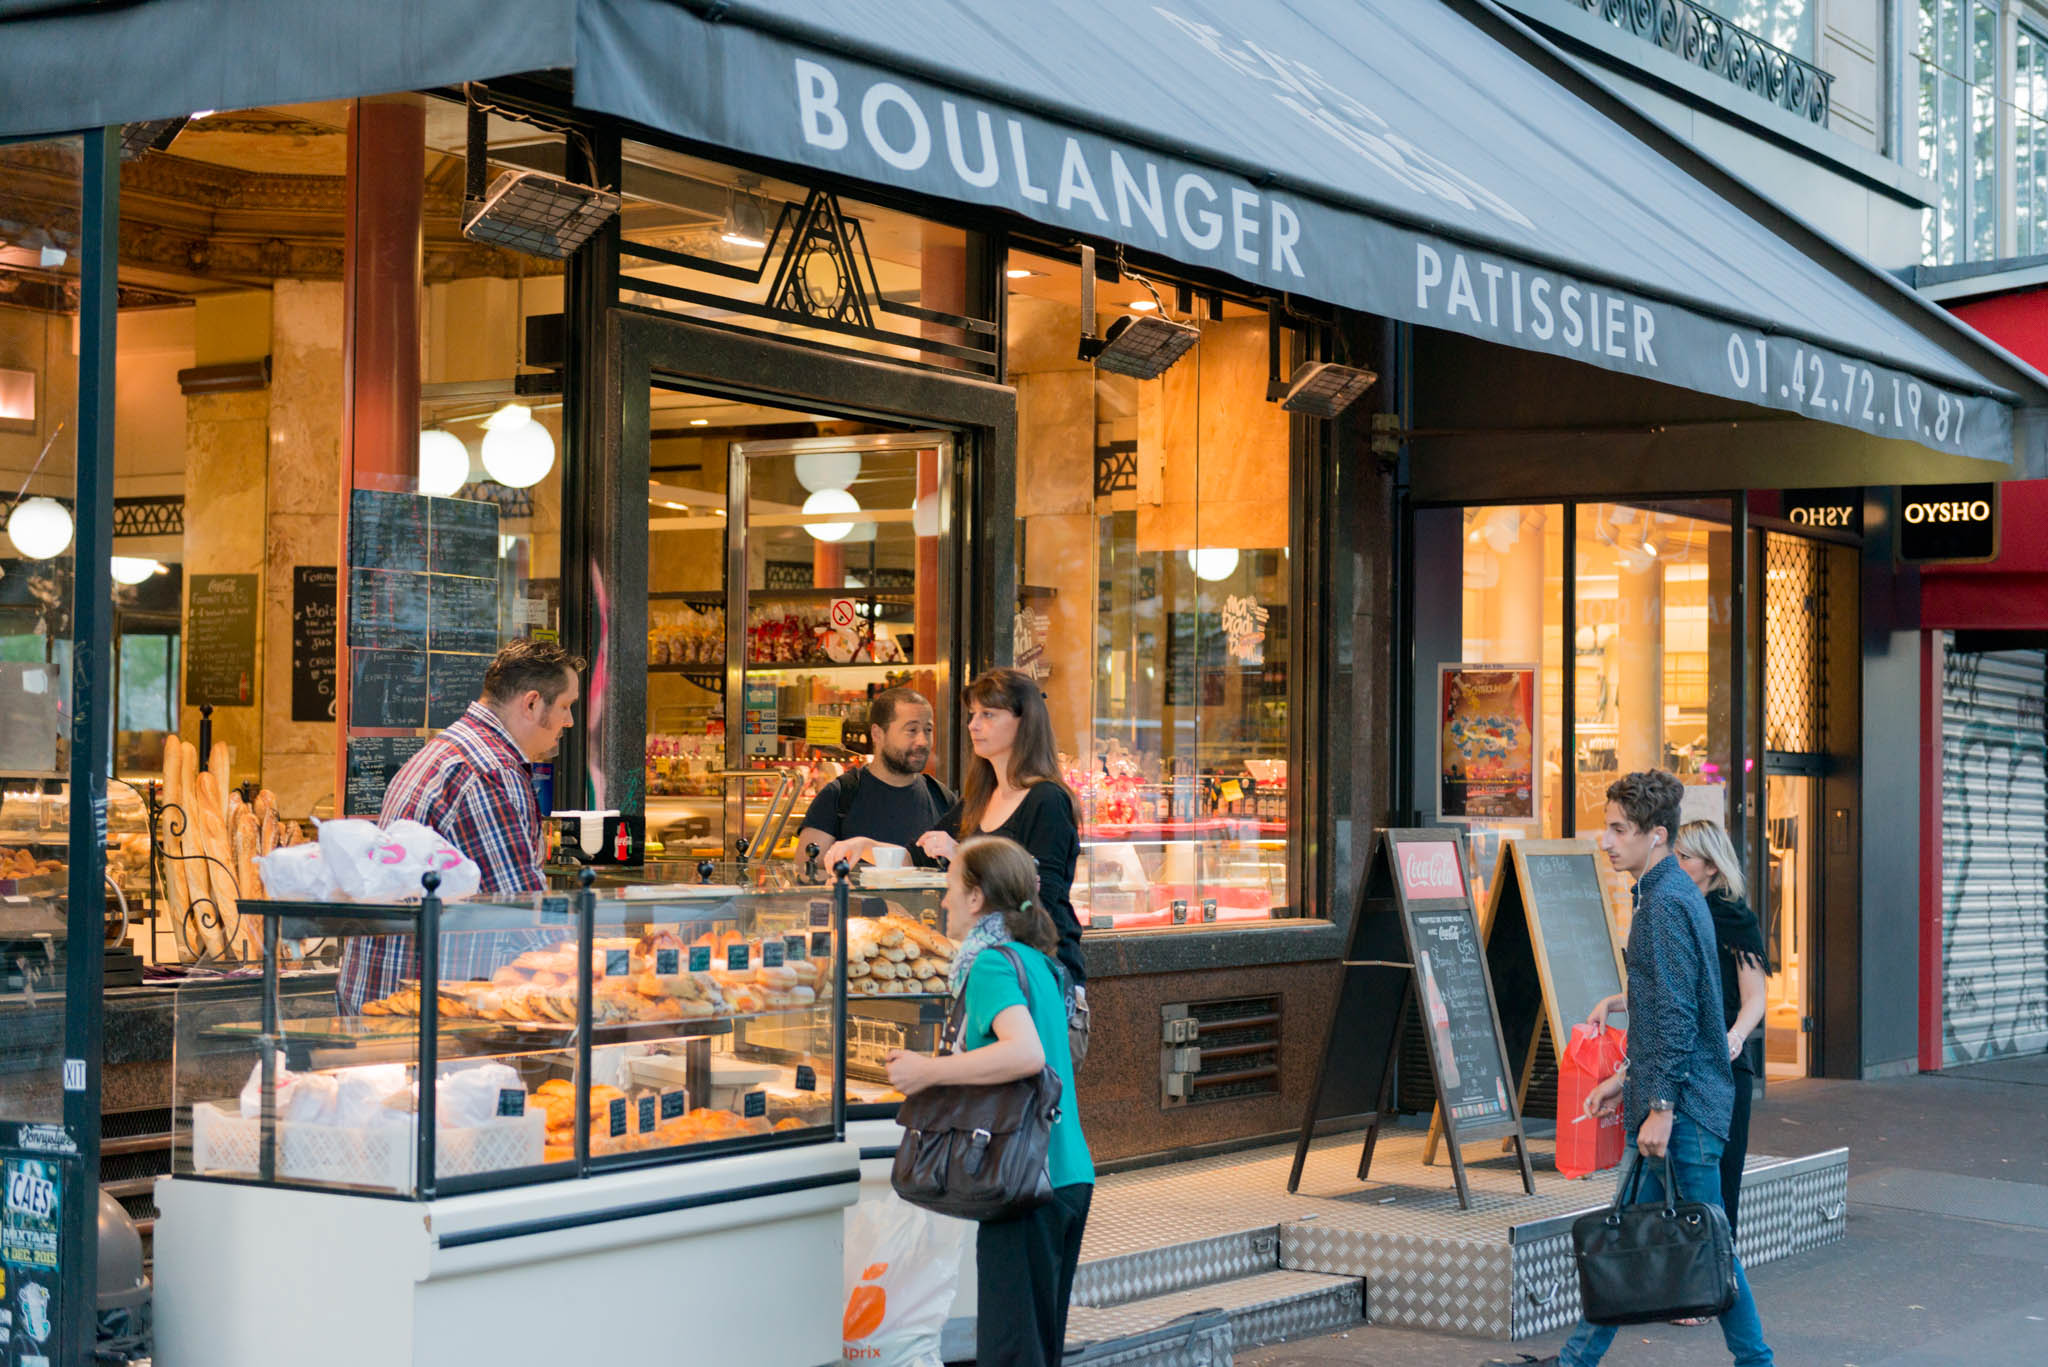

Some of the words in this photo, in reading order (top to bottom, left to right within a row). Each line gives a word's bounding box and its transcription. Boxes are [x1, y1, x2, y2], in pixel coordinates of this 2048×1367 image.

[795, 58, 1306, 280] BOULANGER
[1415, 242, 1659, 368] PATISSIER
[1905, 501, 1991, 523] OYSHO
[13, 1174, 50, 1215] CAES
